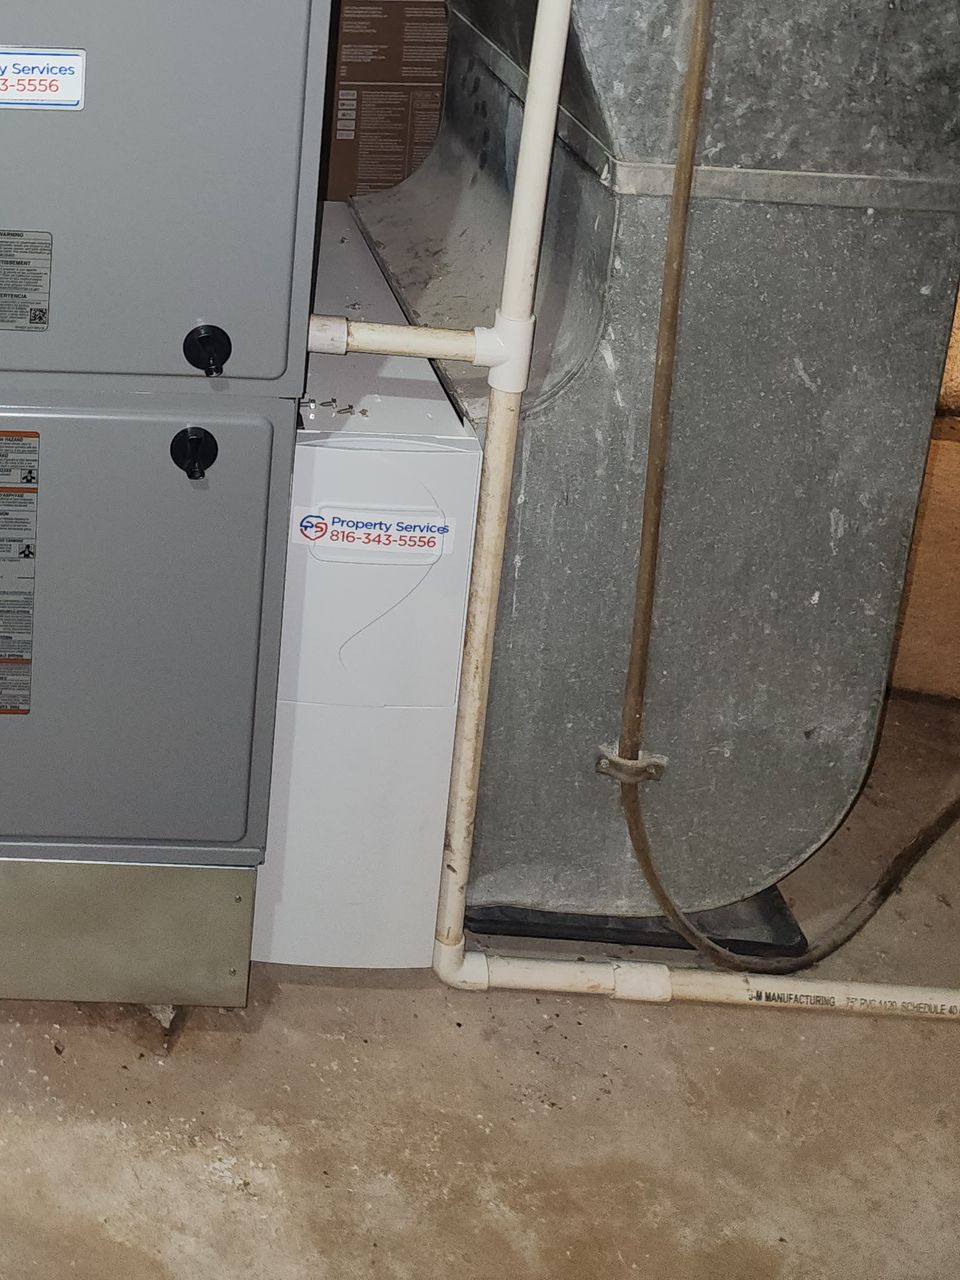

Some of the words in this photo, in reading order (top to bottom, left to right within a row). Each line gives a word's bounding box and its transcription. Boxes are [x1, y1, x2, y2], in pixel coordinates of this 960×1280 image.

[12, 63, 75, 76] Services
[331, 516, 392, 533] Property
[396, 521, 449, 535] Services
[330, 529, 437, 548] 816-343-5556
[764, 991, 835, 1007] MANUFACTURING
[901, 1001, 946, 1015] SCHEDULE
[948, 1004, 959, 1015] 40
